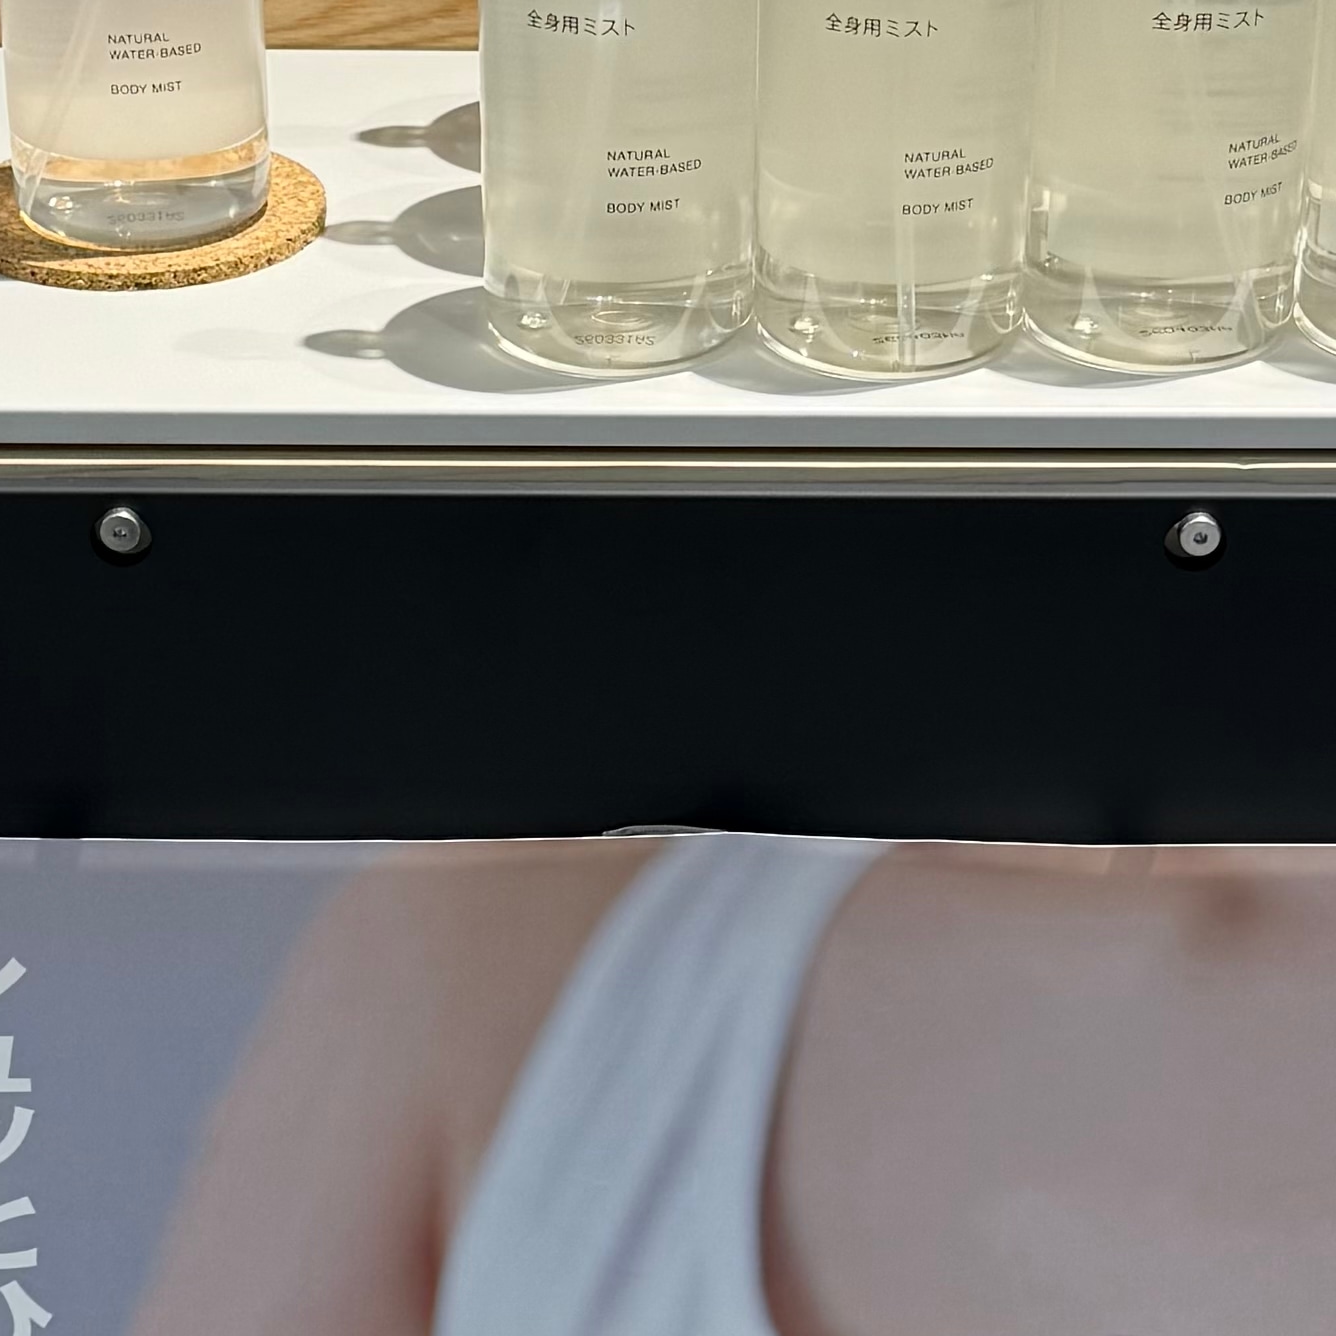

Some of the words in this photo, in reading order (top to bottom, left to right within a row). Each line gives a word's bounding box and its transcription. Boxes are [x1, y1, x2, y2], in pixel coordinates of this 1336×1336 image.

[527, 10, 635, 37] 全身用ミスト
[825, 13, 939, 39] 全身用ミスト
[1152, 10, 1264, 32] 全身用ミスト
[108, 32, 170, 44] NATURAL
[110, 83, 147, 95] BODY
[1228, 133, 1280, 153] NATURAL
[607, 148, 671, 162] NATURAL
[904, 149, 967, 163] NATURAL
[1224, 191, 1258, 205] BODY
[607, 201, 644, 214] BODY
[902, 201, 940, 215] BODY
